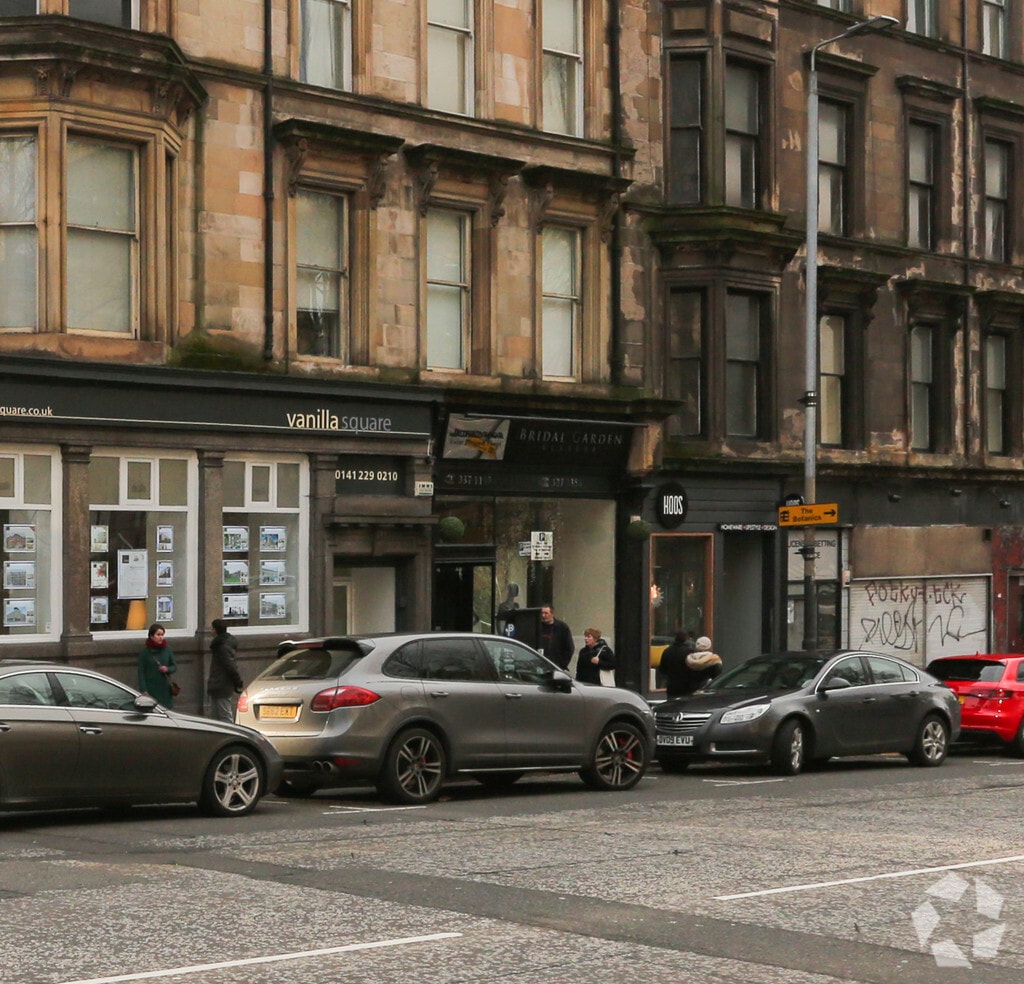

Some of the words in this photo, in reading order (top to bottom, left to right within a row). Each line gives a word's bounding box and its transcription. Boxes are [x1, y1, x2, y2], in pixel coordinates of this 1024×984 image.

[286, 408, 339, 430] vanilla
[341, 415, 392, 435] square
[519, 428, 566, 443] BRIDAL
[574, 431, 624, 446] GARDEN
[335, 469, 357, 480] 0141
[358, 470, 375, 480] 229
[376, 471, 398, 481] 0210
[663, 495, 683, 515] HOOS
[801, 507, 814, 515] The
[792, 514, 822, 523] Botanics
